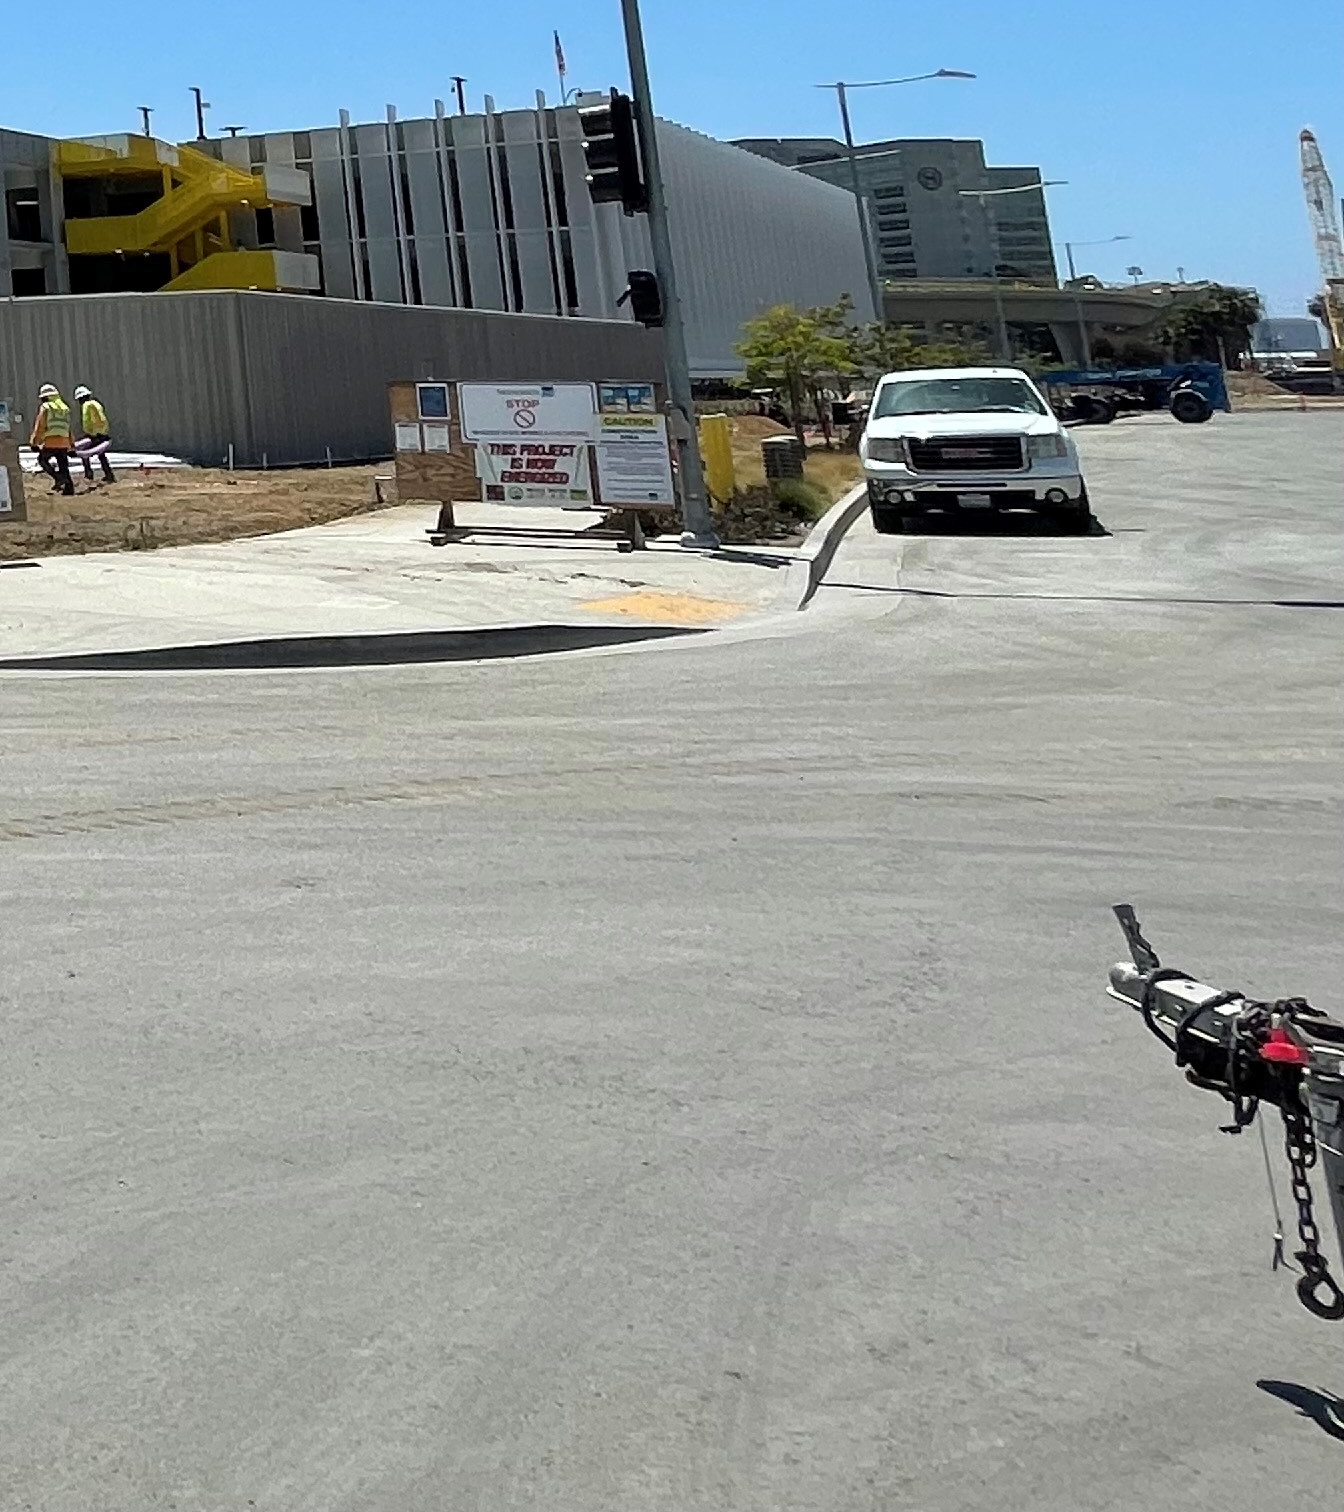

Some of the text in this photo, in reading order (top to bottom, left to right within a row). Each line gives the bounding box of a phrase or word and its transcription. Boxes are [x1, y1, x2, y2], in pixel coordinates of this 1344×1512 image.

[505, 398, 540, 409] STOP
[603, 416, 654, 426] CAUTION
[489, 443, 577, 457] THIS PROJECT
[510, 457, 558, 470] IS NOW
